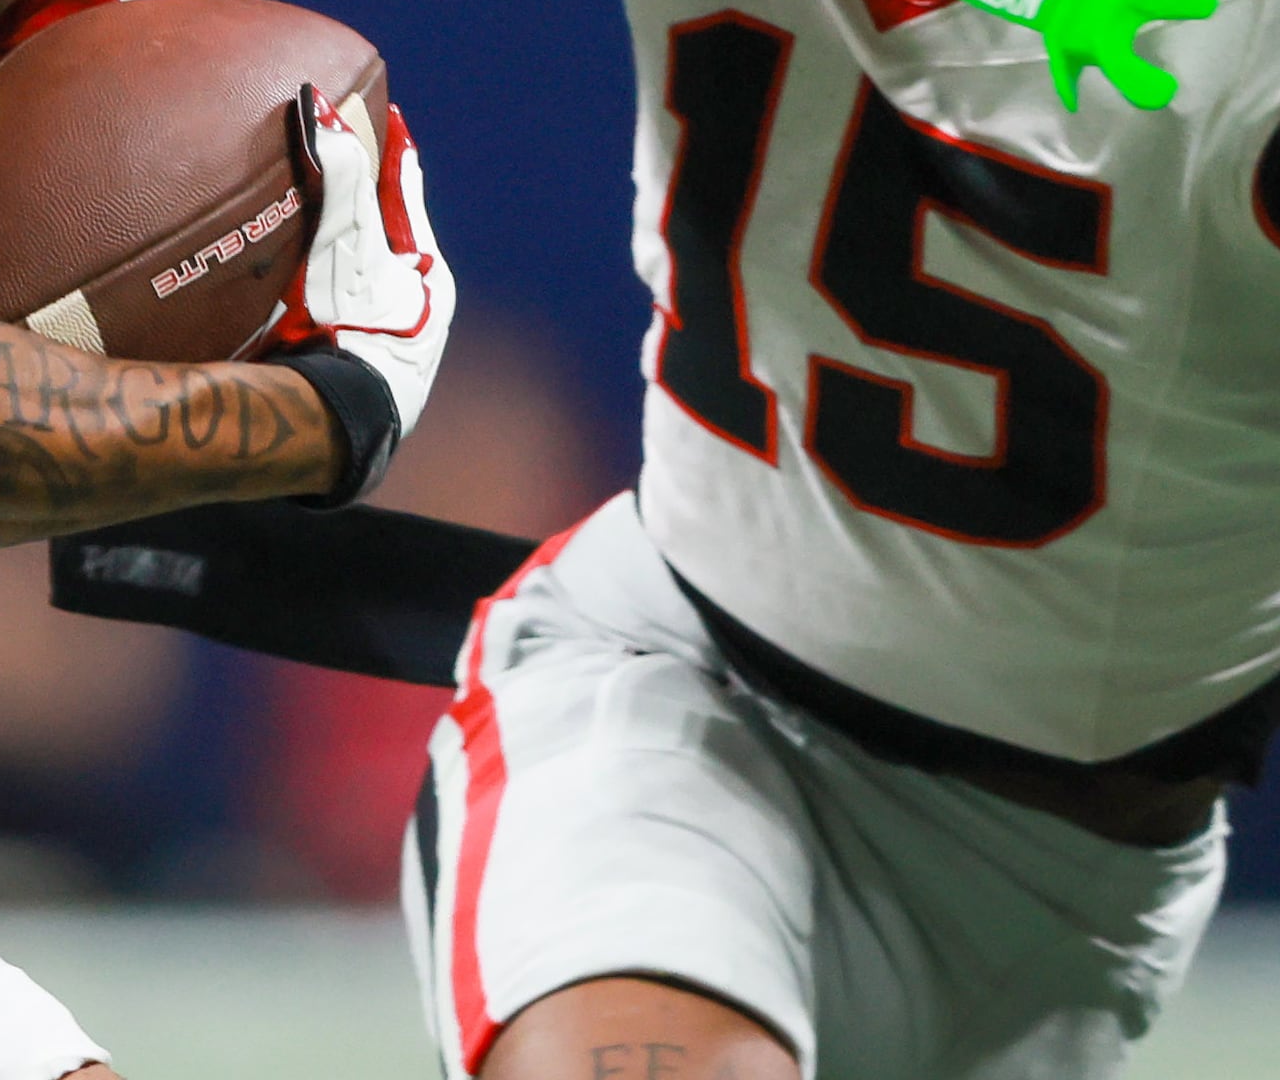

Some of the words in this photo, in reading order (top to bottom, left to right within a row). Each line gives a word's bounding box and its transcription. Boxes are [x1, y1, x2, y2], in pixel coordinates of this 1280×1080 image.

[240, 185, 303, 244] POR
[150, 228, 246, 300] ELITE
[655, 7, 1113, 550] 15
[108, 358, 298, 461] GOD
